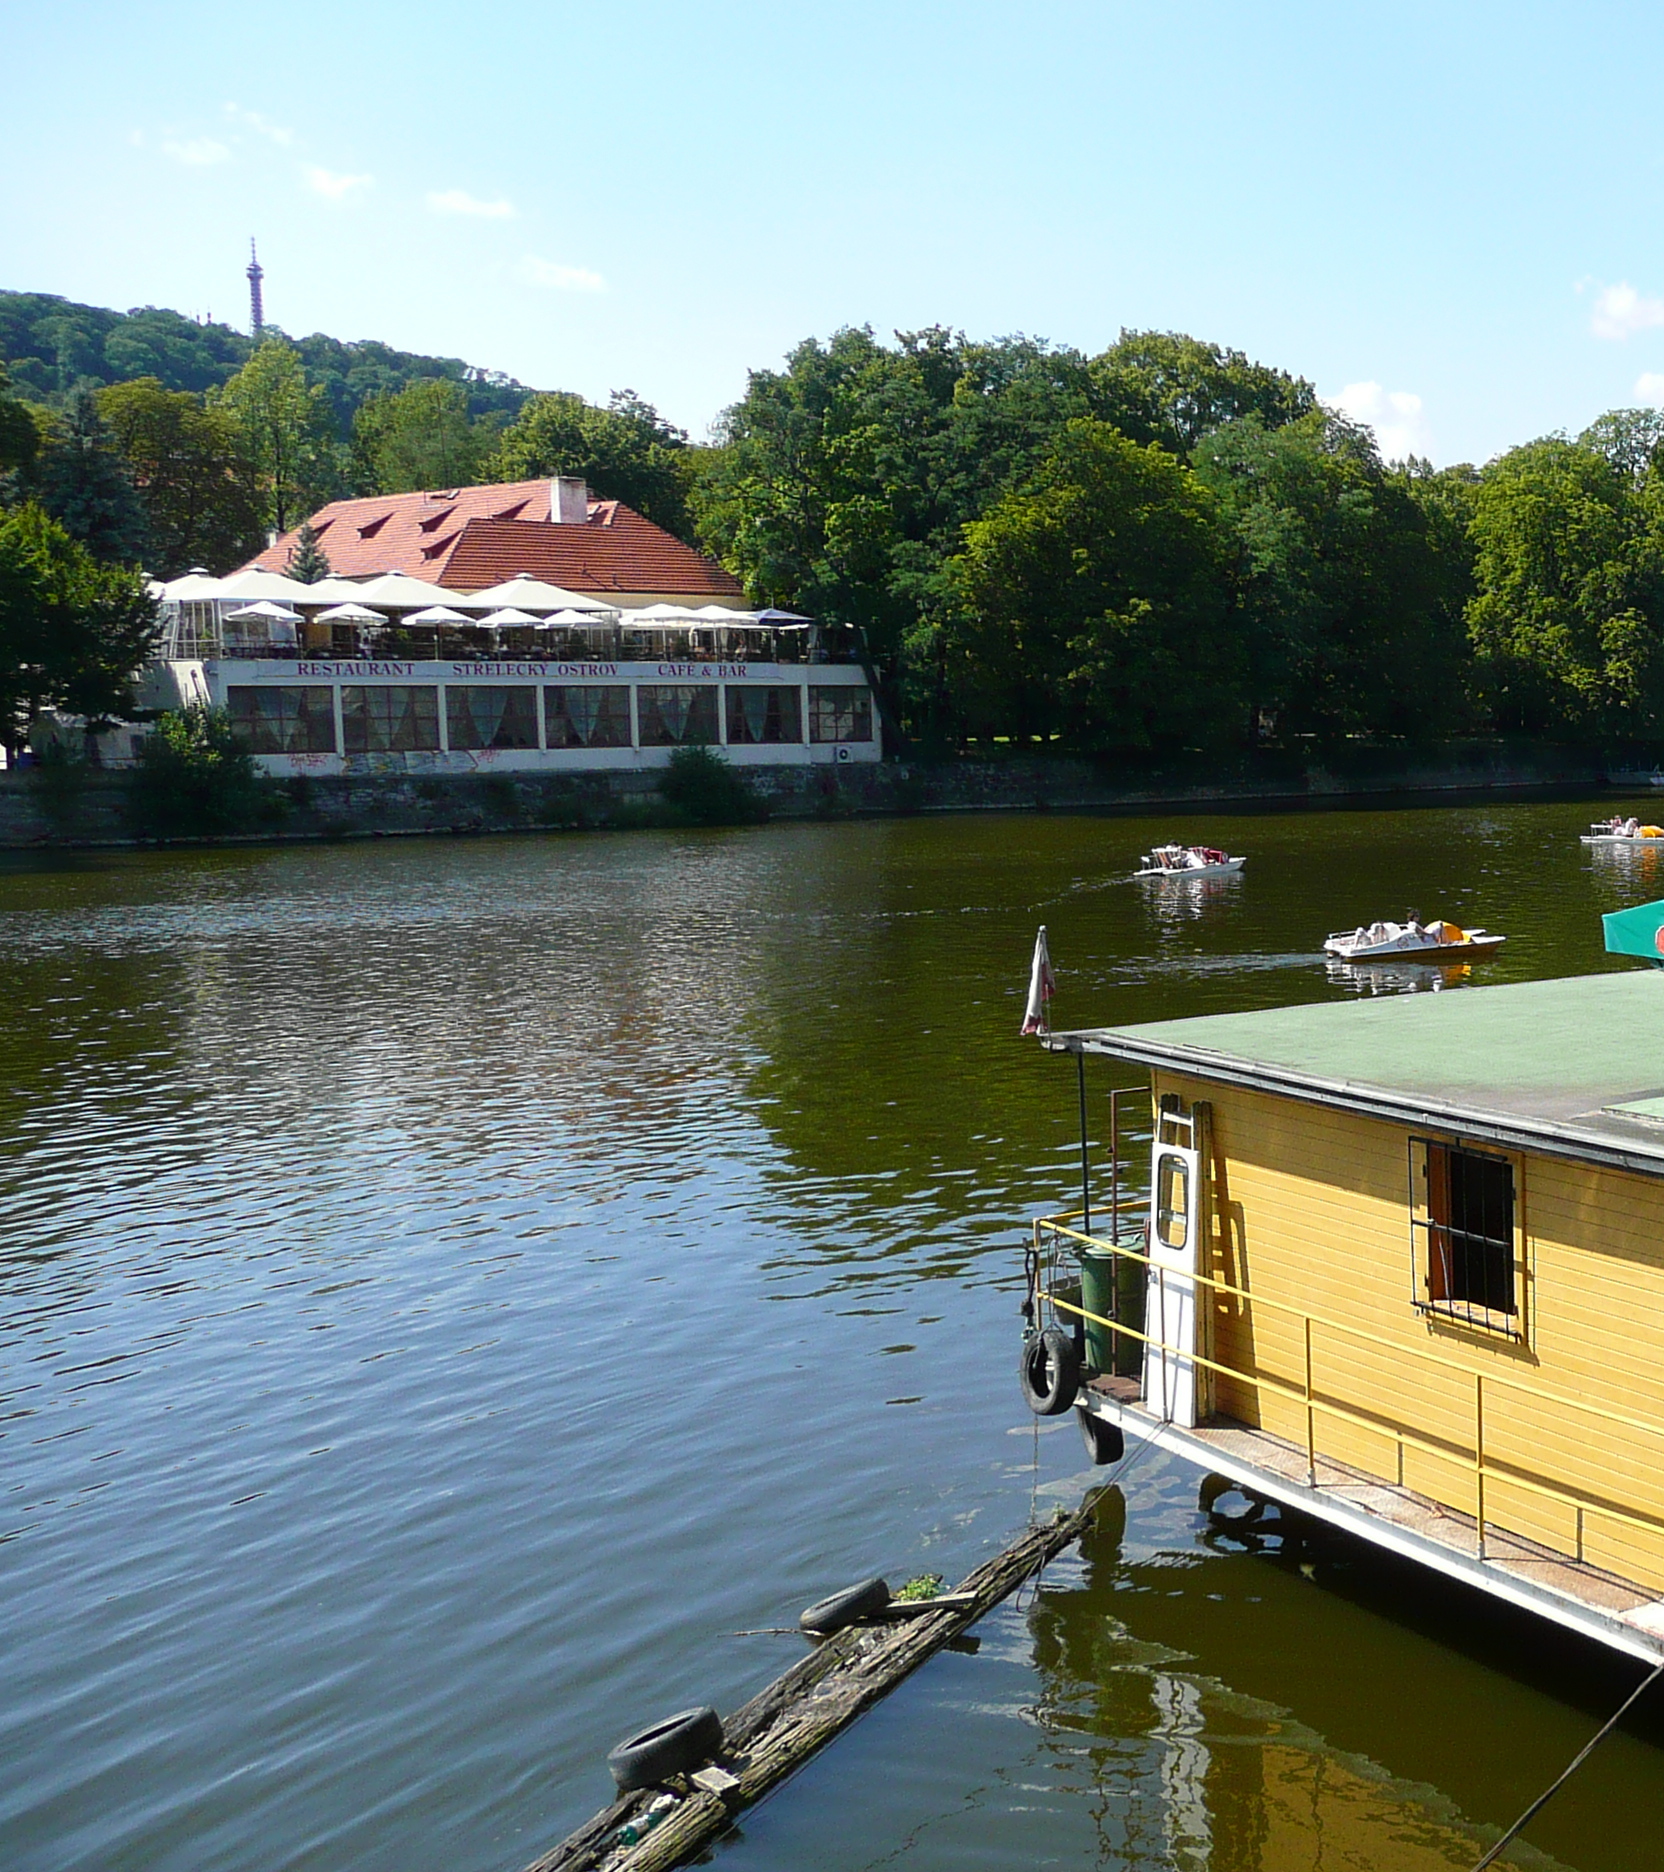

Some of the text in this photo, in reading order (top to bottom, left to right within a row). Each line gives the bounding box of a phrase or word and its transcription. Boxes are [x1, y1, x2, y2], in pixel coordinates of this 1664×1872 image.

[297, 662, 416, 677] RESTAURANT
[557, 663, 619, 677] OSTROV
[701, 665, 712, 677] &
[718, 664, 747, 677] BAR
